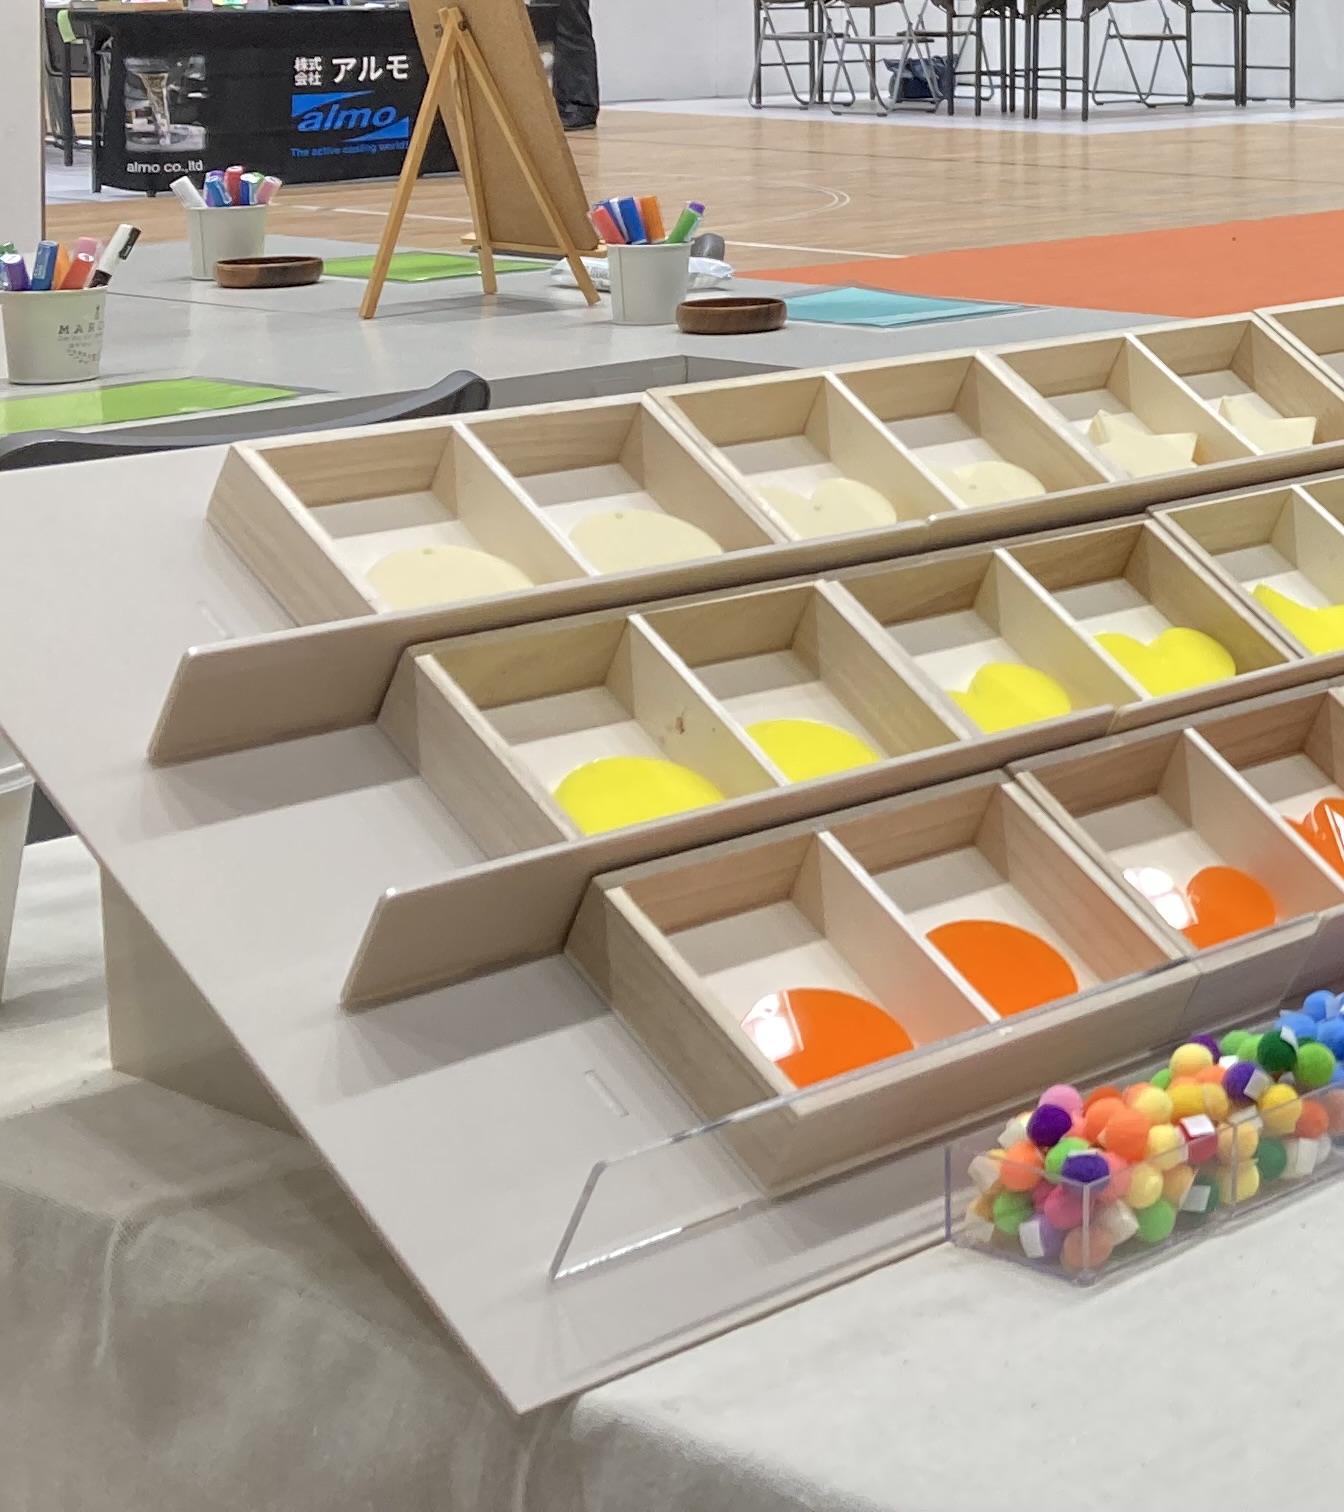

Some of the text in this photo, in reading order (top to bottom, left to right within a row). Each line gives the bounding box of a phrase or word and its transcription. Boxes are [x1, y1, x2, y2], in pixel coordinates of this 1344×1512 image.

[331, 54, 410, 83] アルモ
[298, 103, 397, 132] almo
[126, 161, 160, 173] almo
